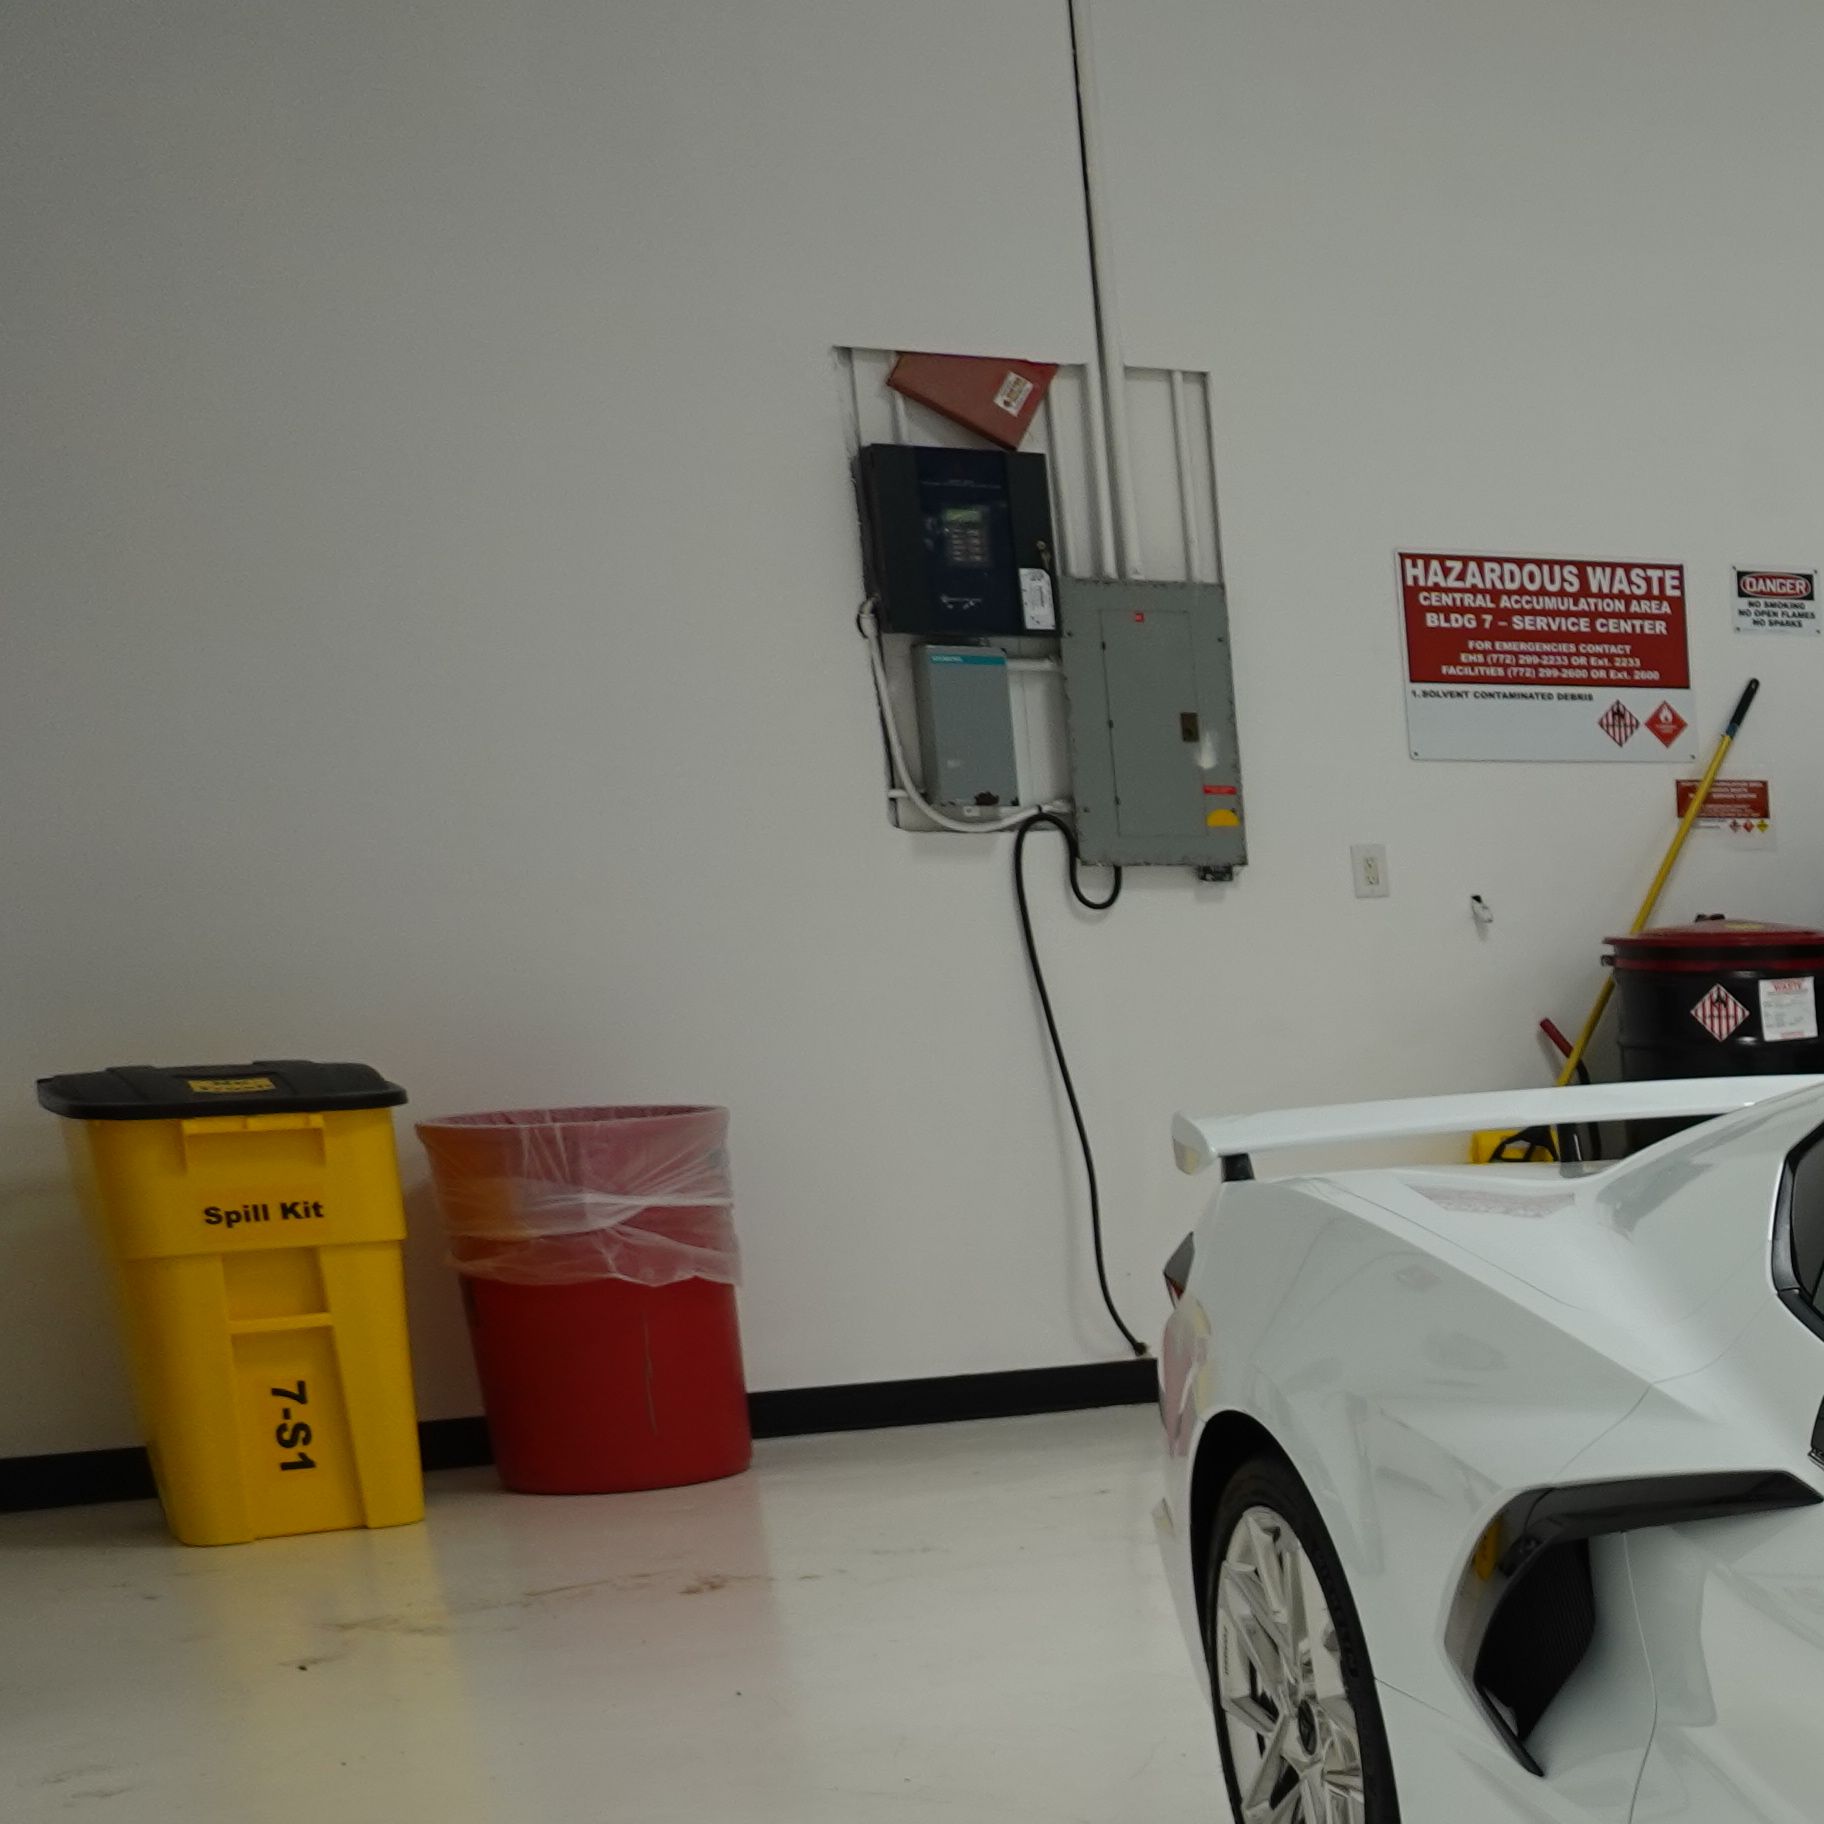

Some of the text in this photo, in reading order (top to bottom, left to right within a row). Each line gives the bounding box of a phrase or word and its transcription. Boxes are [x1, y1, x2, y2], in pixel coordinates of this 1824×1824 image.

[1404, 558, 1682, 597] HAZARDOUS WASTE
[1745, 577, 1807, 594] DANGER
[1418, 591, 1672, 615] CENTRAL ACCUMULATION AREA
[1748, 600, 1806, 610] NO SMOKING
[1738, 608, 1816, 619] NO OPEN FLAMES
[1425, 612, 1477, 628] BLDG
[1481, 614, 1493, 629] 7
[1511, 615, 1591, 632] SERVICE
[1595, 618, 1668, 635] CENTER
[1752, 618, 1803, 628] NO SPARKS
[1467, 639, 1632, 655] FOR EMERGENCIES CONTACT
[1571, 656, 1588, 666] OR
[1441, 664, 1505, 676] FACILITIES
[1590, 669, 1607, 679] OR
[1422, 690, 1470, 699] SOLVENT
[1473, 690, 1554, 700] CONTAMINATED
[1557, 692, 1594, 701] DEBRIS
[203, 1201, 325, 1229] Spill Kit
[271, 1380, 317, 1471] 7-S1
